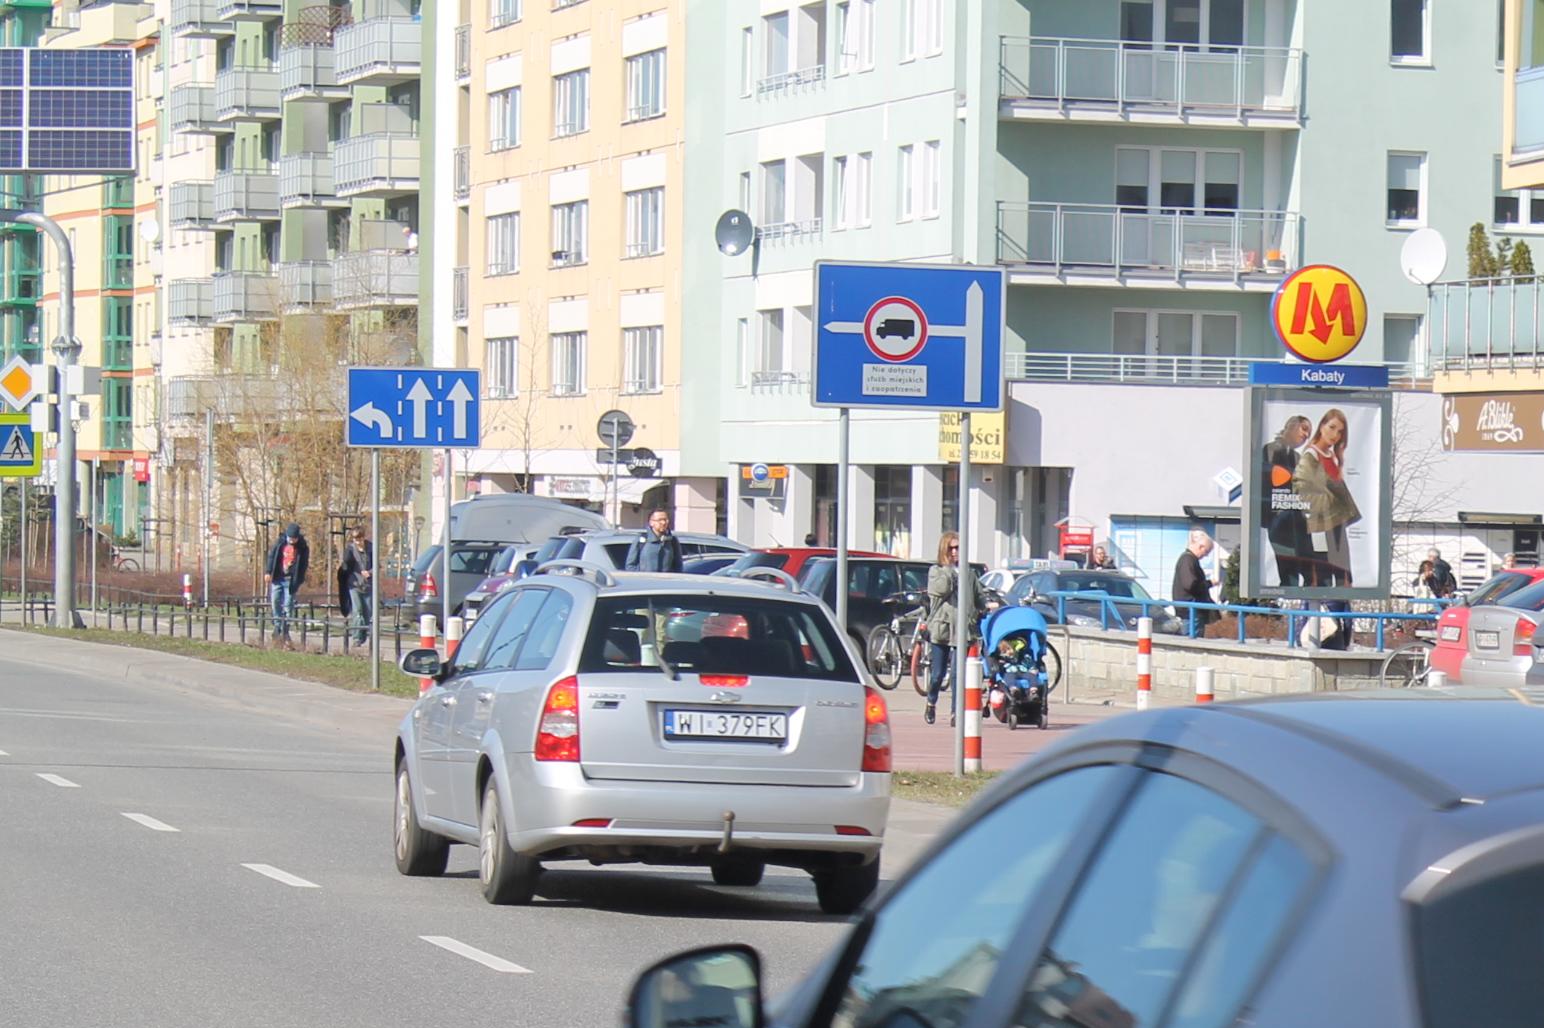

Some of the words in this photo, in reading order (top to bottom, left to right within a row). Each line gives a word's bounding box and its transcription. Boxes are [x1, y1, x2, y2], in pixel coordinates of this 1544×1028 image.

[888, 367, 916, 375] dotyczy
[889, 376, 925, 384] miejskich
[1301, 368, 1345, 385] Kabaty
[1271, 502, 1311, 510] FASHION
[678, 713, 704, 734] WI
[717, 714, 782, 736] 379FK
